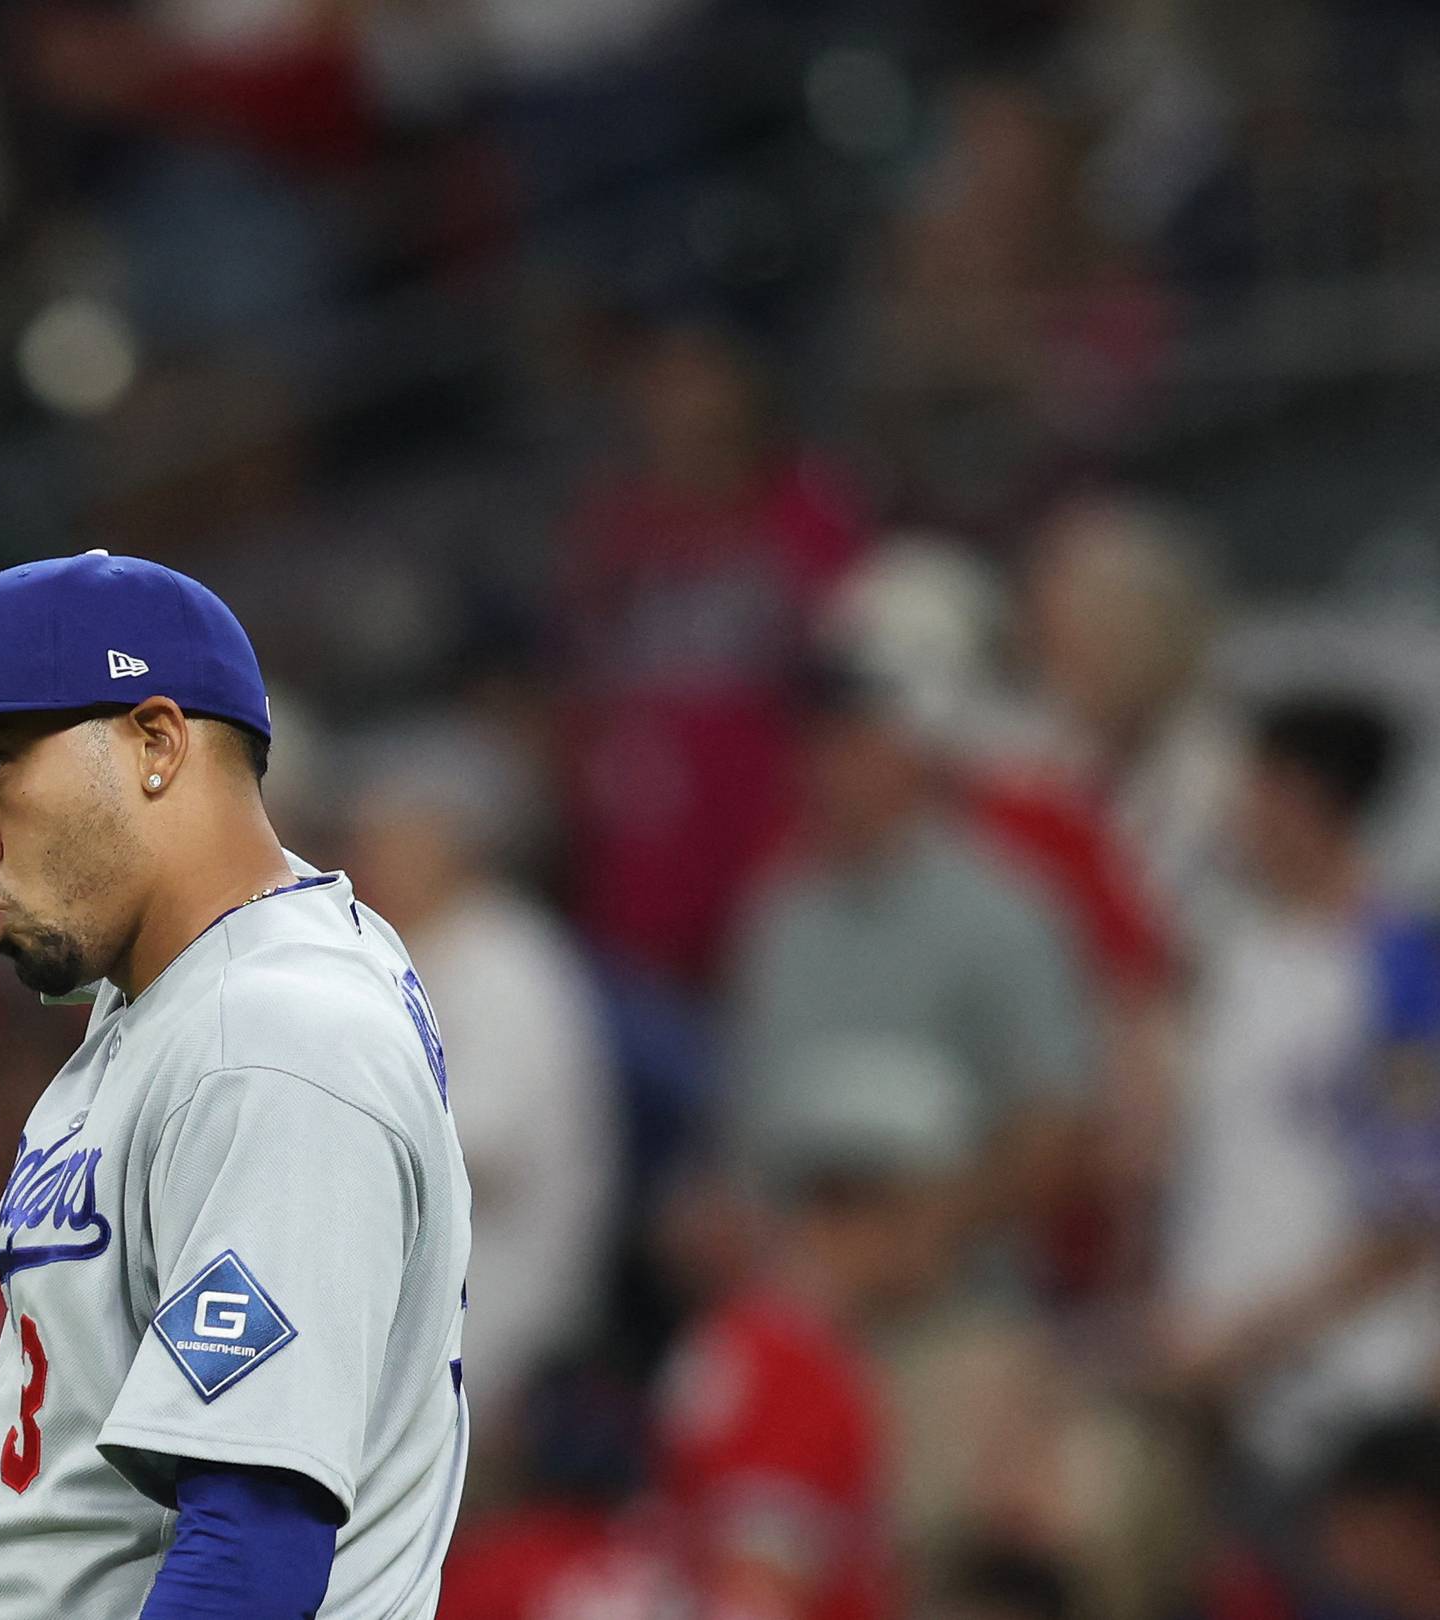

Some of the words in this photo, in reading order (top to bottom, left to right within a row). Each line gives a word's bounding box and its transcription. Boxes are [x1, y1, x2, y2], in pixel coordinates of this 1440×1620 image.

[194, 1290, 250, 1340] G
[176, 1340, 257, 1358] GUGGENHEIM
[0, 1313, 48, 1495] 3
